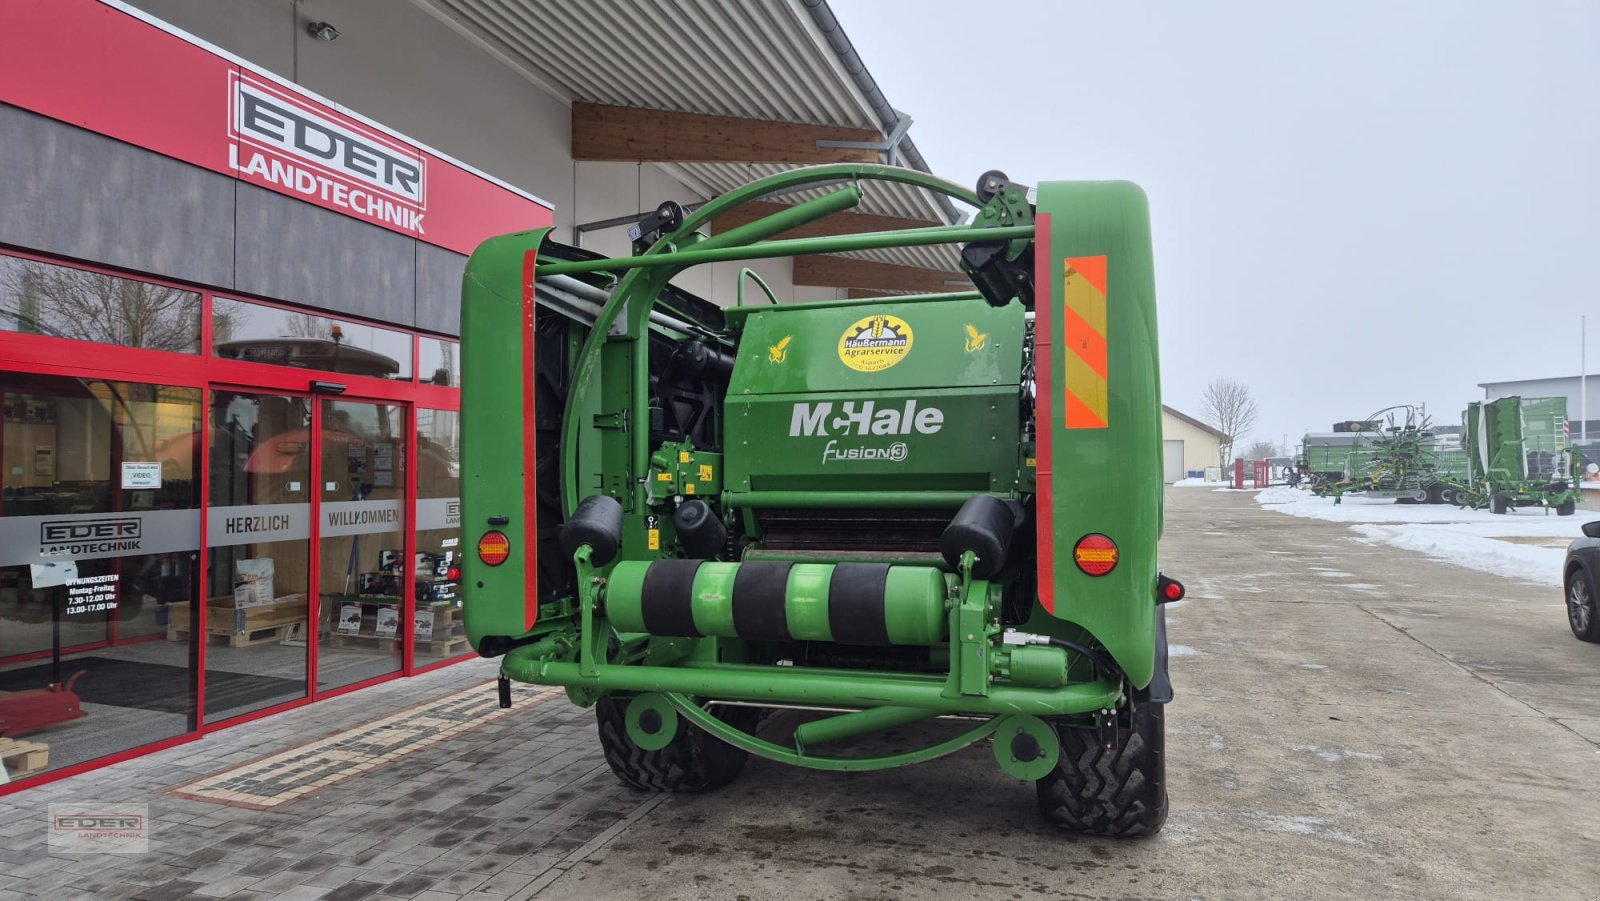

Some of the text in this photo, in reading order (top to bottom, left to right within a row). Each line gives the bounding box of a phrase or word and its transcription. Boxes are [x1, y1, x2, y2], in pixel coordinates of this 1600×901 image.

[240, 91, 419, 194] EDER
[229, 143, 424, 234] LANDTECHNIK
[846, 338, 906, 348] Häußermann
[845, 346, 904, 357] Agrarservice
[789, 399, 944, 437] McHale
[226, 515, 289, 534] HERZLICH
[328, 509, 399, 526] WILLKOMMEN
[46, 522, 138, 539] EDER
[40, 541, 141, 556] LANDTECHNIK
[66, 574, 119, 586] ÖFFNUNGSZEITEN
[69, 585, 115, 595] Montag-Freitag
[68, 593, 116, 605] 7.30-12.00 Uhr
[66, 602, 118, 615] 13.00-17.00 Uhr
